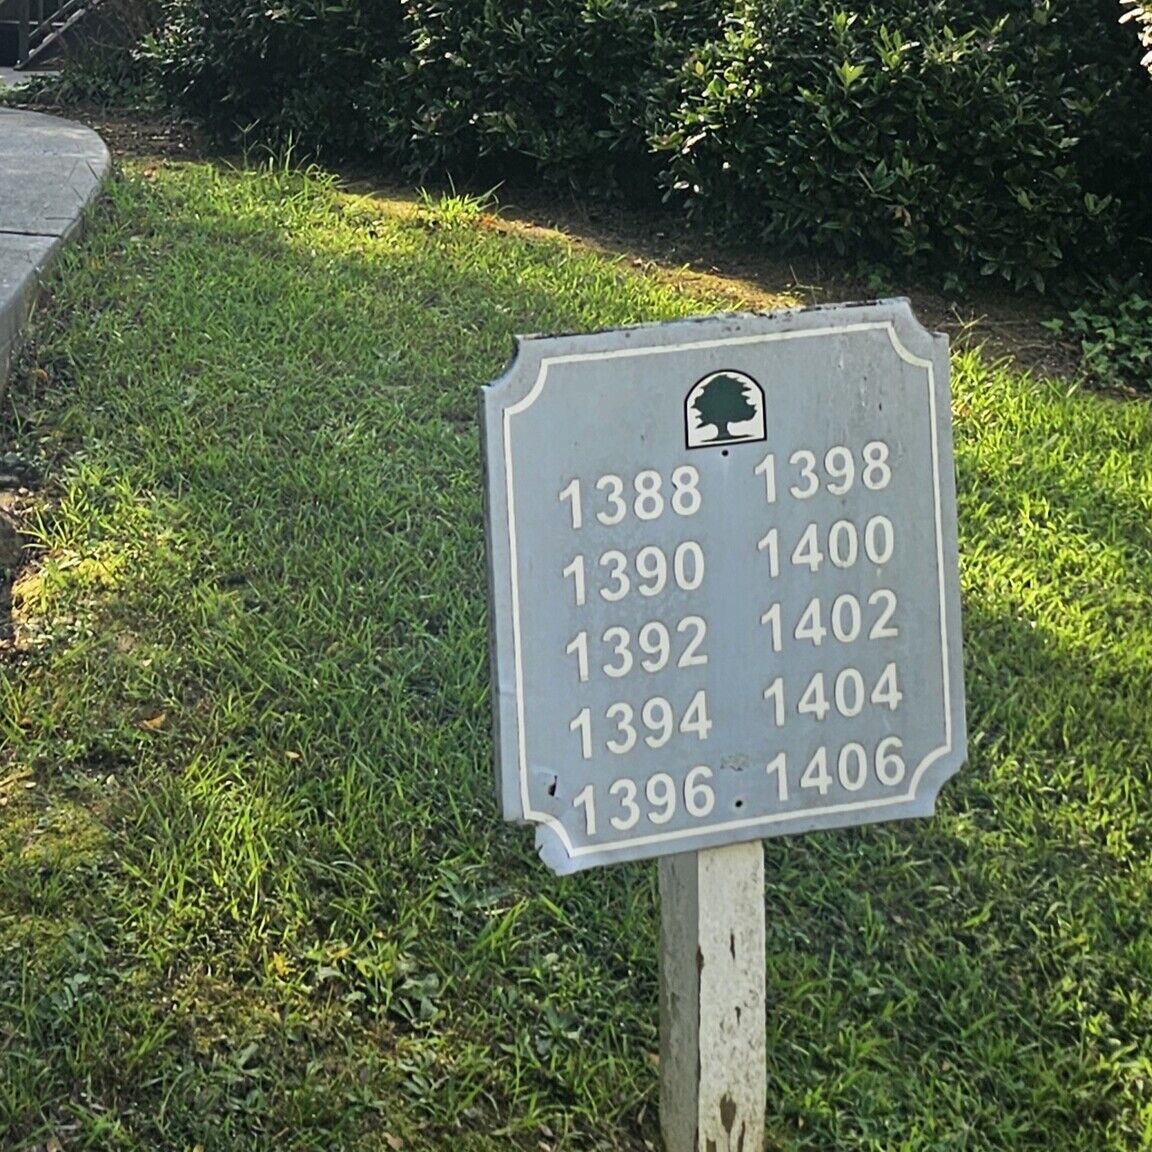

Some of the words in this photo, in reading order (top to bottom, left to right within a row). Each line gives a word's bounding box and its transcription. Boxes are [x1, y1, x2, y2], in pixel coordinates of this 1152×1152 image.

[559, 465, 702, 529] 1388
[755, 441, 892, 504] 1398
[563, 541, 704, 606] 1390
[758, 516, 895, 578] 1400
[566, 616, 708, 682] 1392
[761, 589, 898, 652] 1402
[570, 690, 712, 759] 1394
[763, 662, 902, 727] 1404
[573, 765, 715, 836] 1396
[766, 736, 905, 802] 1406
